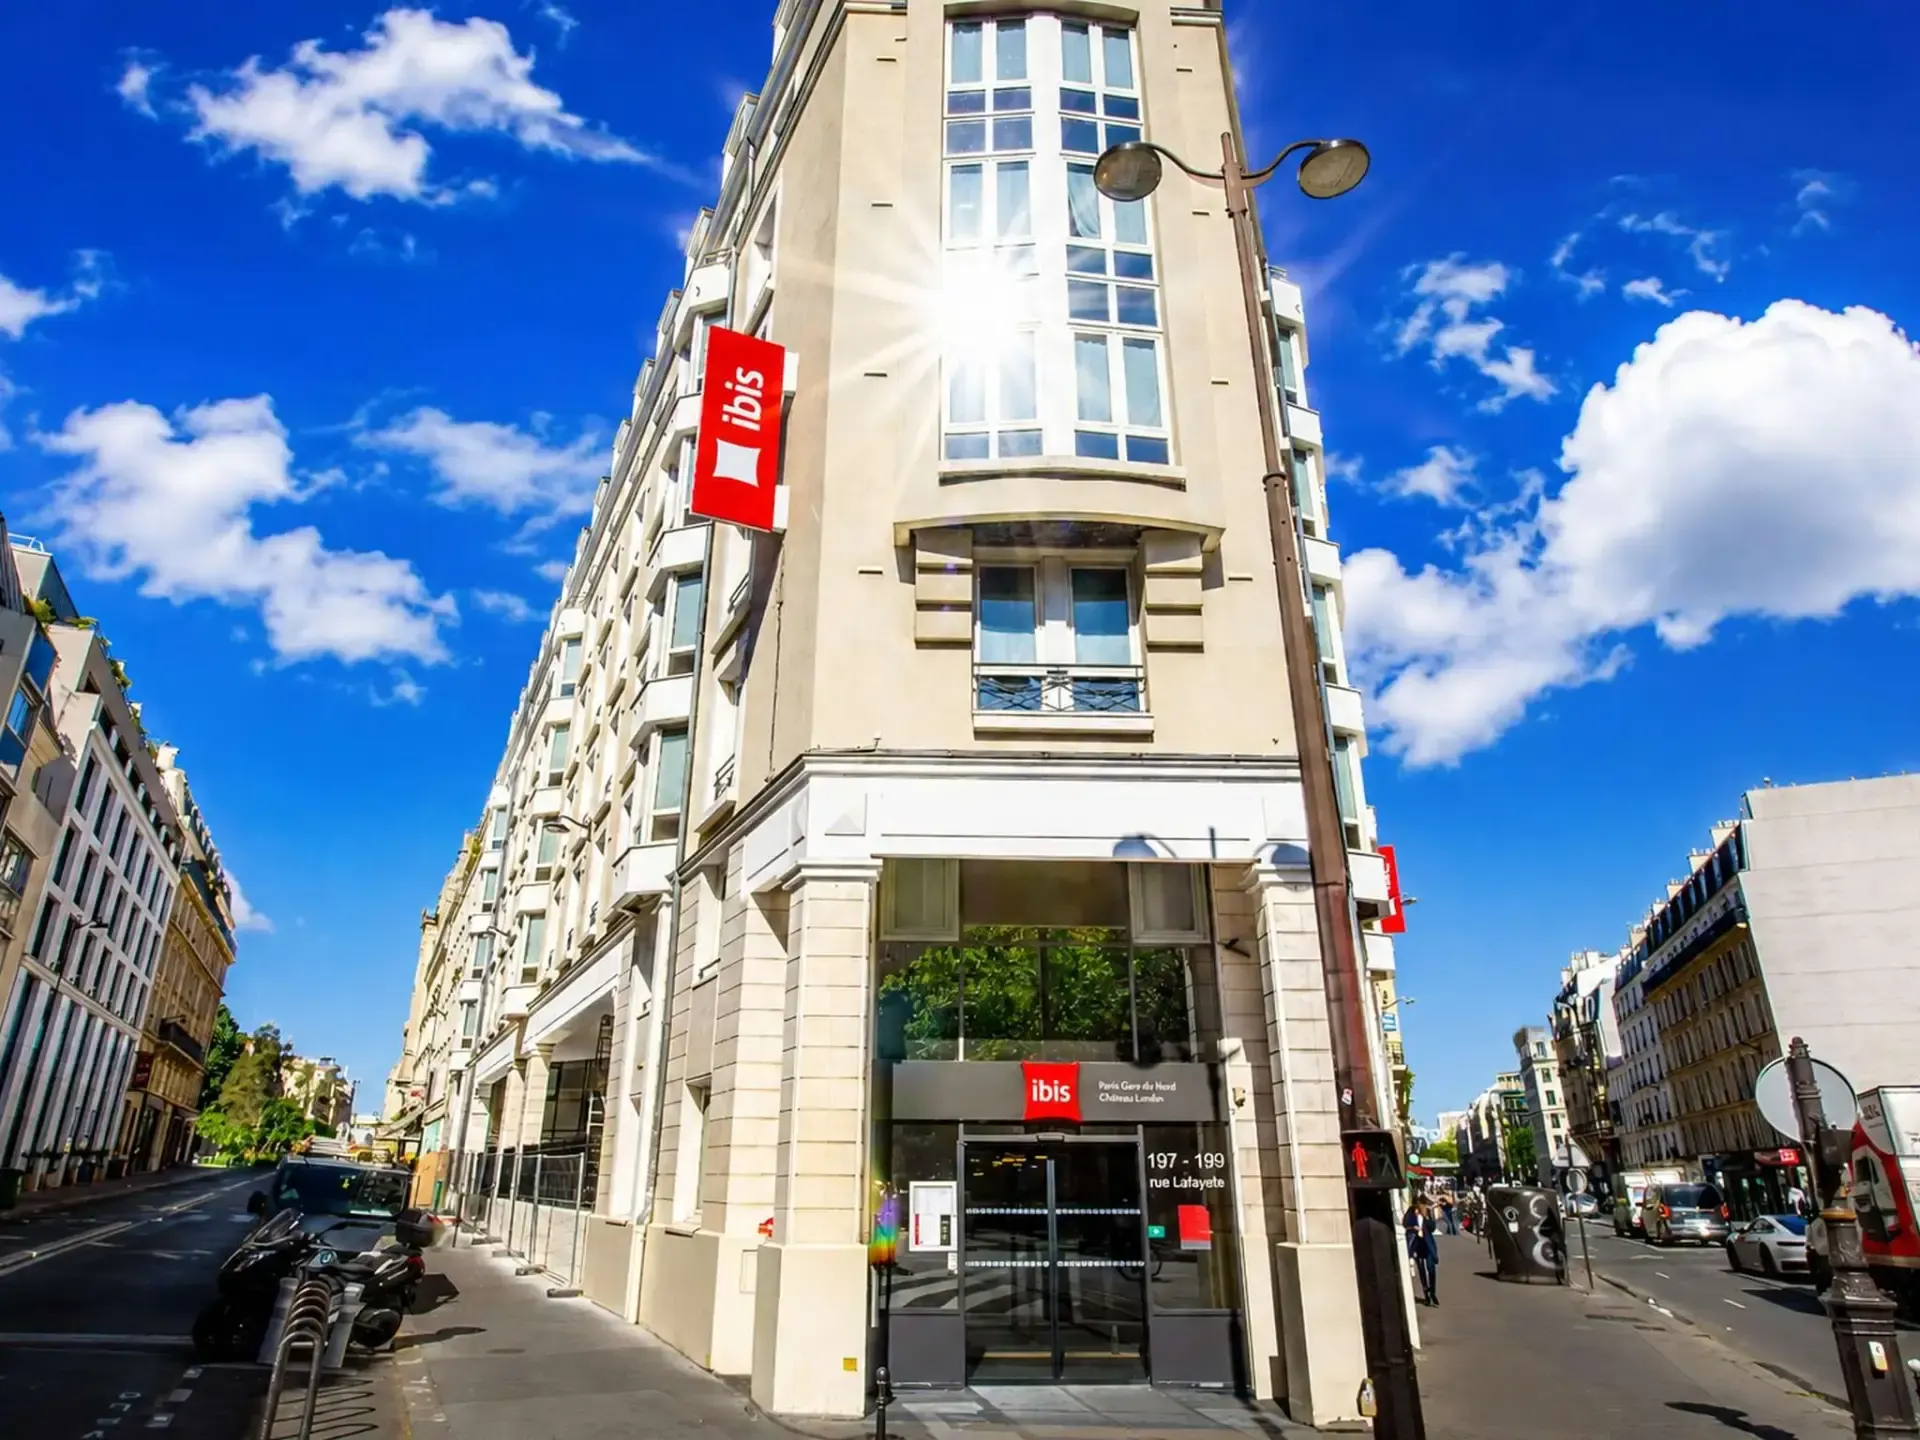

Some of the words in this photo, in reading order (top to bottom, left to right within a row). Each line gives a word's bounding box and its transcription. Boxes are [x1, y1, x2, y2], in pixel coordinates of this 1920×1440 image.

[721, 366, 764, 432] ibis
[1032, 1078, 1071, 1103] ibis
[1098, 1080, 1120, 1091] Paris
[1147, 1152, 1178, 1169] 197
[1194, 1152, 1225, 1169] 199
[1149, 1178, 1171, 1188] rue
